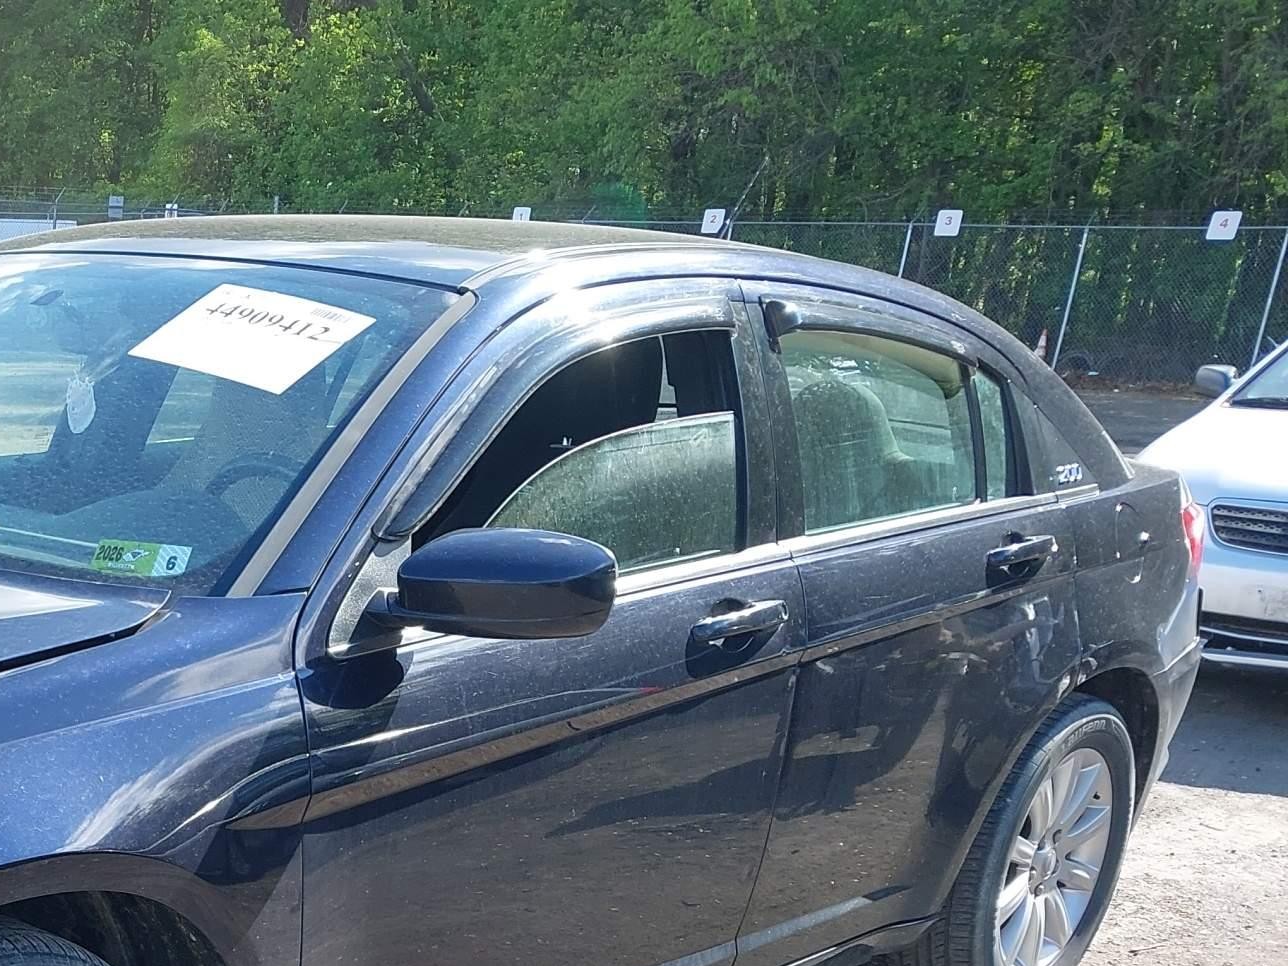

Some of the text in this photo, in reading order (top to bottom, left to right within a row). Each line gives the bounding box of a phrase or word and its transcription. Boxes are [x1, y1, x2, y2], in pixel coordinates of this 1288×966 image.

[709, 214, 718, 224] 2
[944, 216, 953, 226] 3
[1219, 217, 1230, 229] 4
[205, 302, 331, 341] 44909412
[95, 545, 124, 562] 2026
[166, 555, 178, 571] 6
